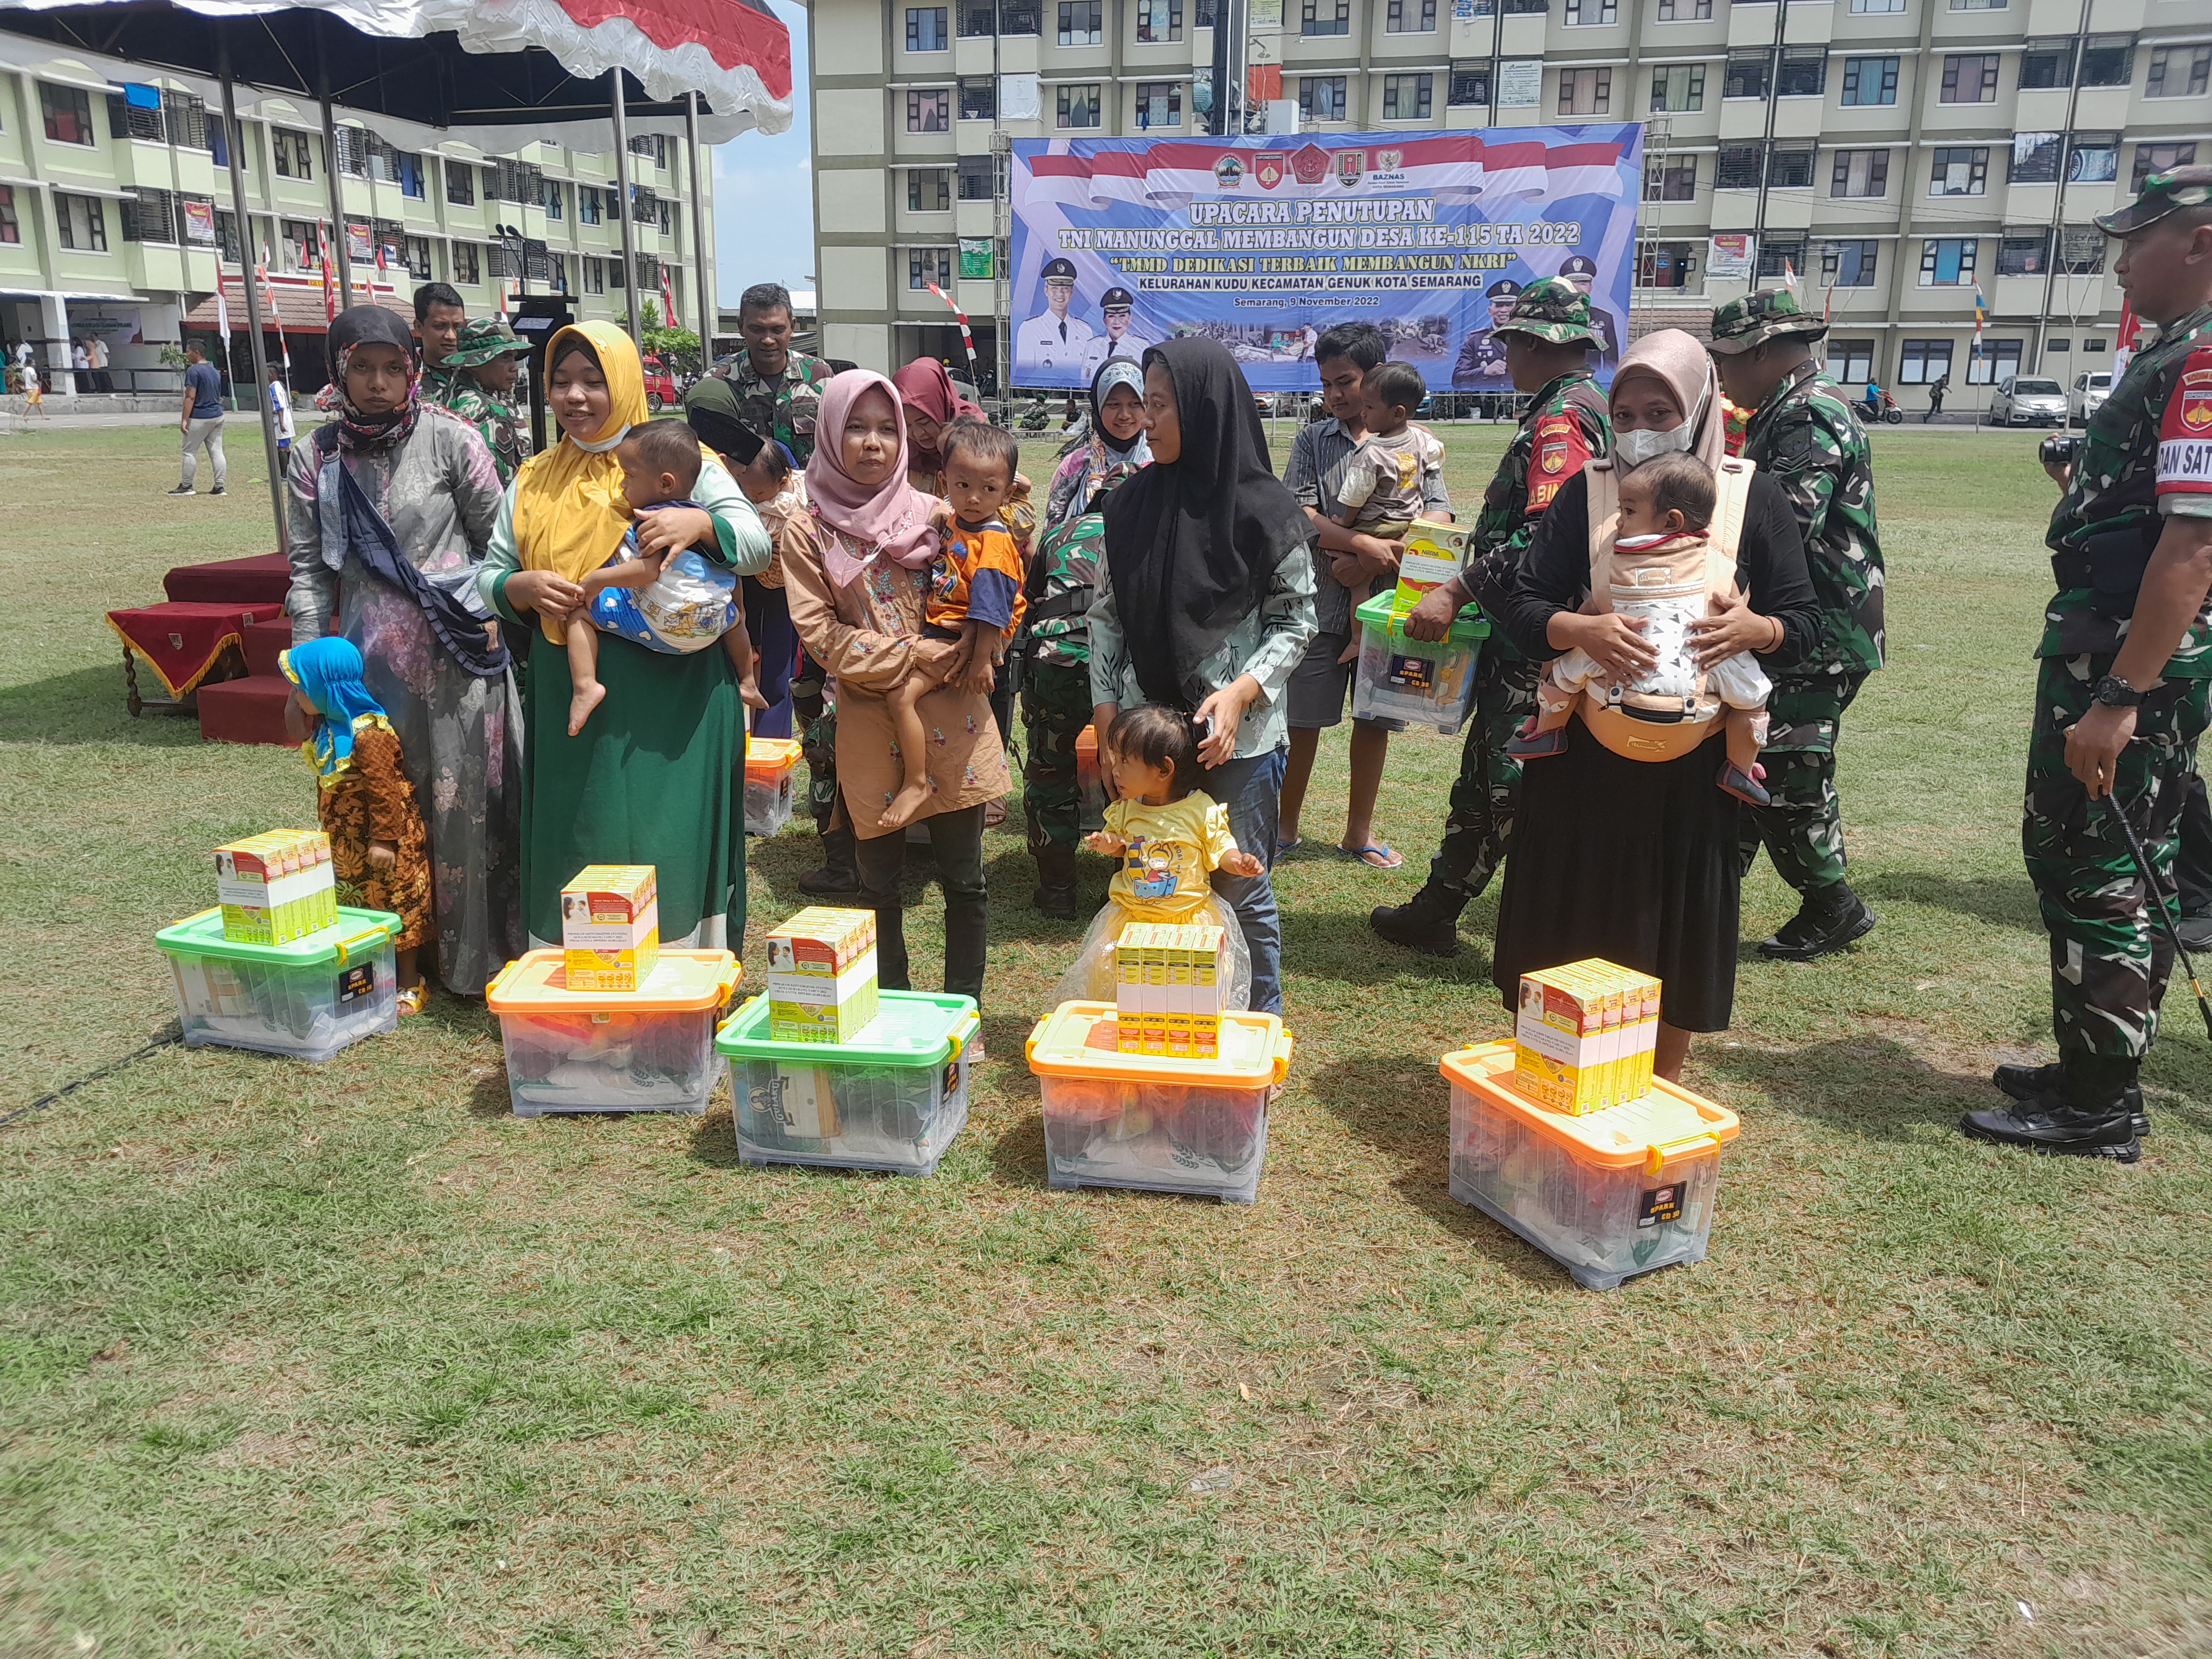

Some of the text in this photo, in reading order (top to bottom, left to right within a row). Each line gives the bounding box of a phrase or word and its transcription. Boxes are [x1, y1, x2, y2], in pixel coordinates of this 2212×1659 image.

[1189, 199, 1435, 224] UPACARA PENUTUPAN
[1059, 223, 1579, 249] TNI MANUNGGAL MEMBANGUN DESA KE-115 TA 2022
[1173, 257, 1255, 273] DEDIKASI
[1259, 256, 1338, 272] TERBAIK
[1342, 255, 1455, 272] MEMBANGUN
[1139, 275, 1481, 290] KELURAHAN KUDU KECAMATAN GENUK KOTA SEMARANG
[1234, 297, 1379, 308] Semarang, 9 November 2022
[2157, 445, 2212, 476] DAN SAT
[1399, 670, 1423, 679] SPARK
[771, 1082, 785, 1121] GULAKU
[1650, 1202, 1675, 1214] SPARK
